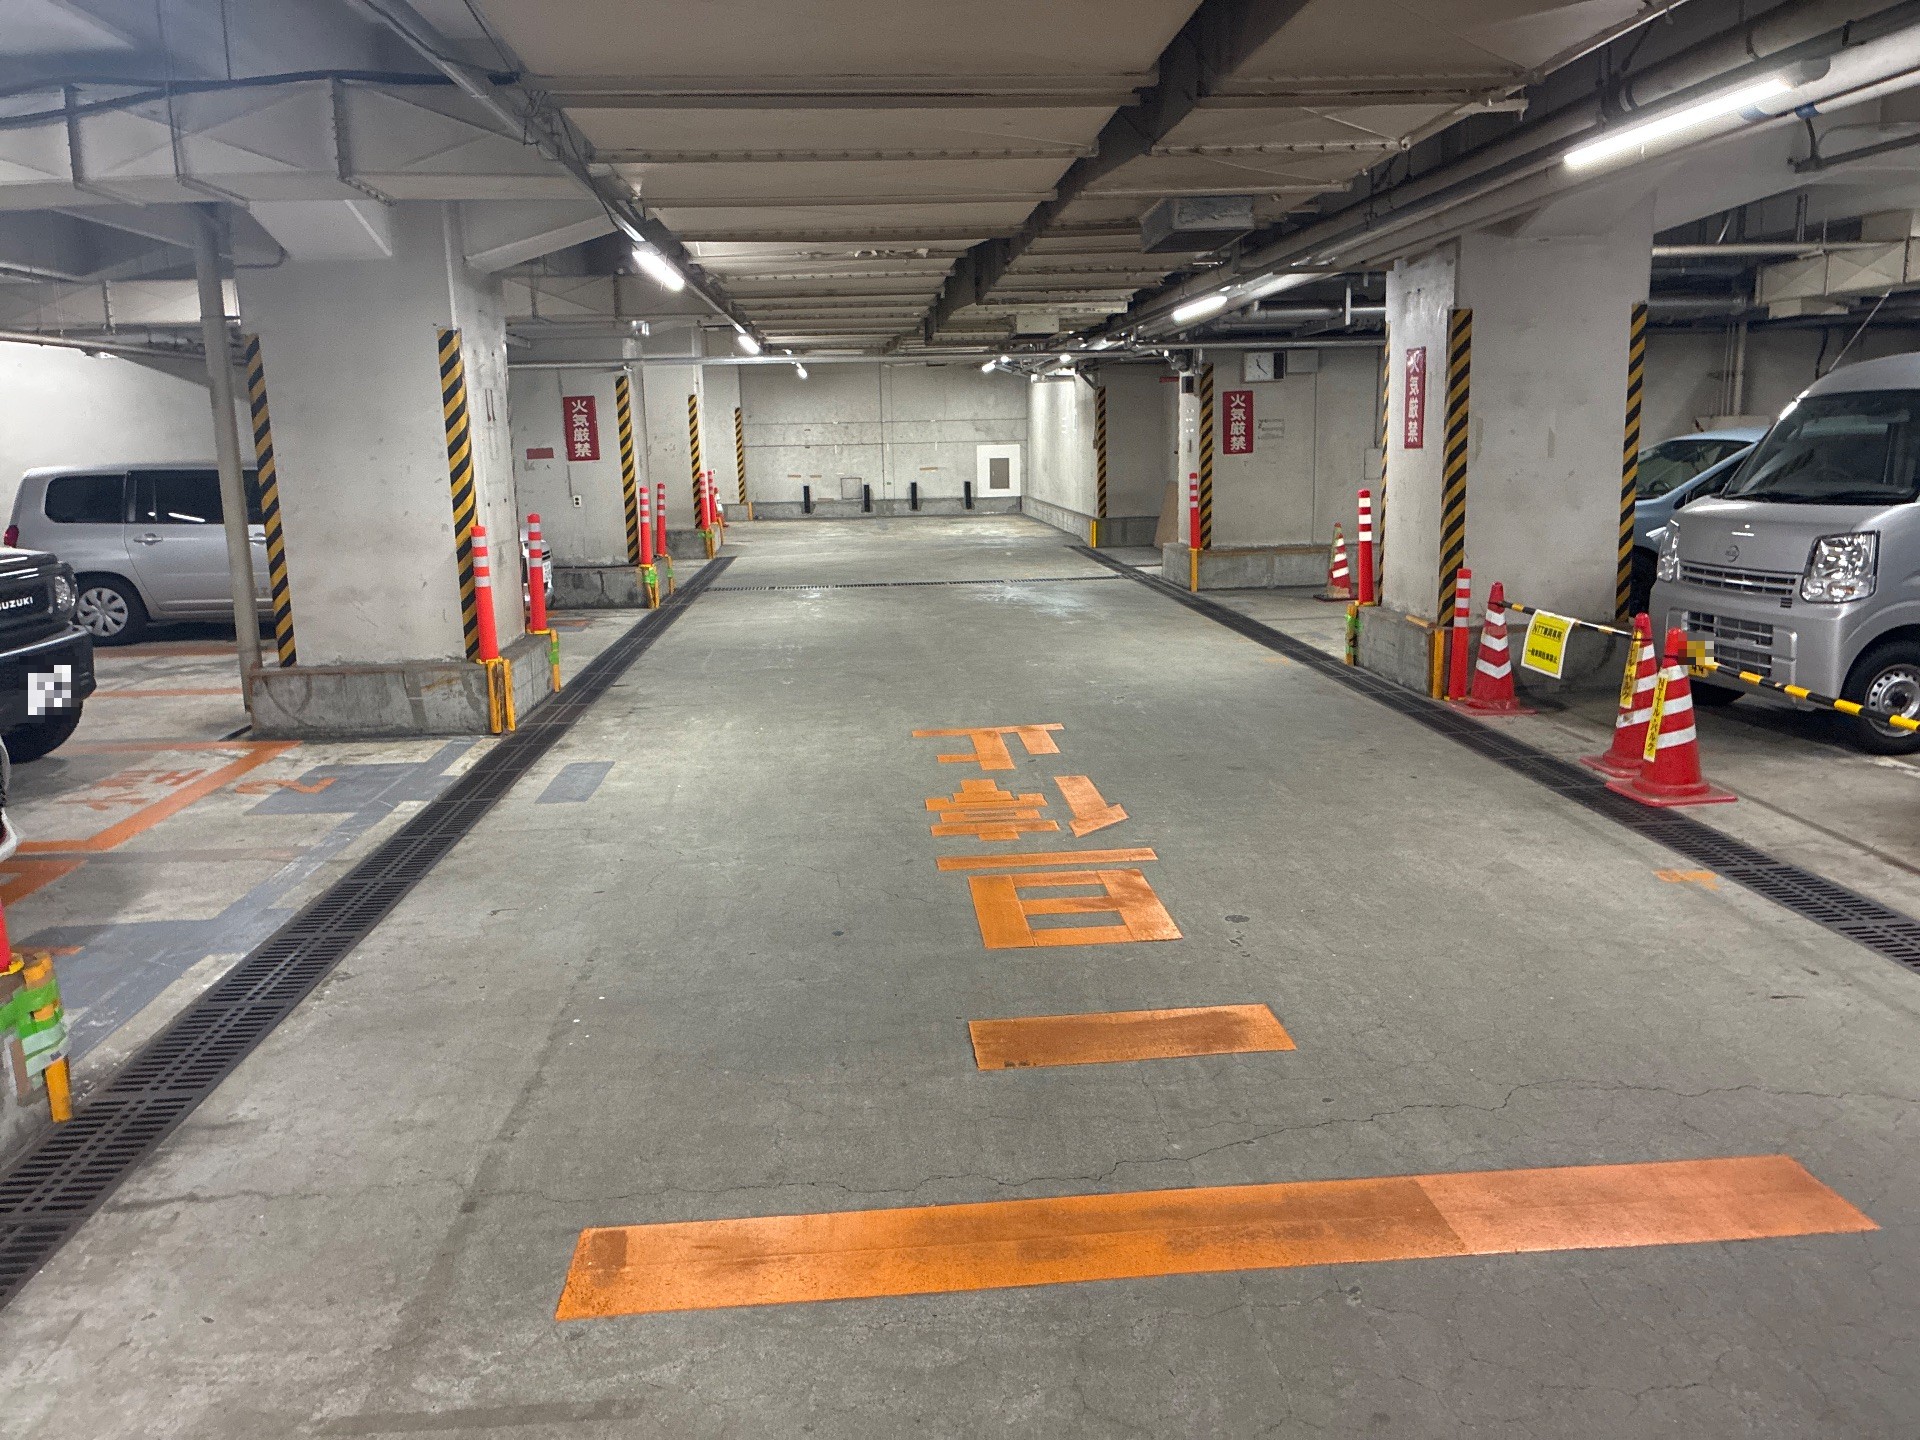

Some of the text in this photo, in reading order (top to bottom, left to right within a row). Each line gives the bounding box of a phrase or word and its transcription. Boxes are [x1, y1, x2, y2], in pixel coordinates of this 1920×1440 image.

[1229, 393, 1247, 451] 火気厳禁
[1406, 349, 1423, 443] 火気厳禁
[571, 399, 592, 458] 火気厳禁
[0, 596, 34, 610] UZUKI
